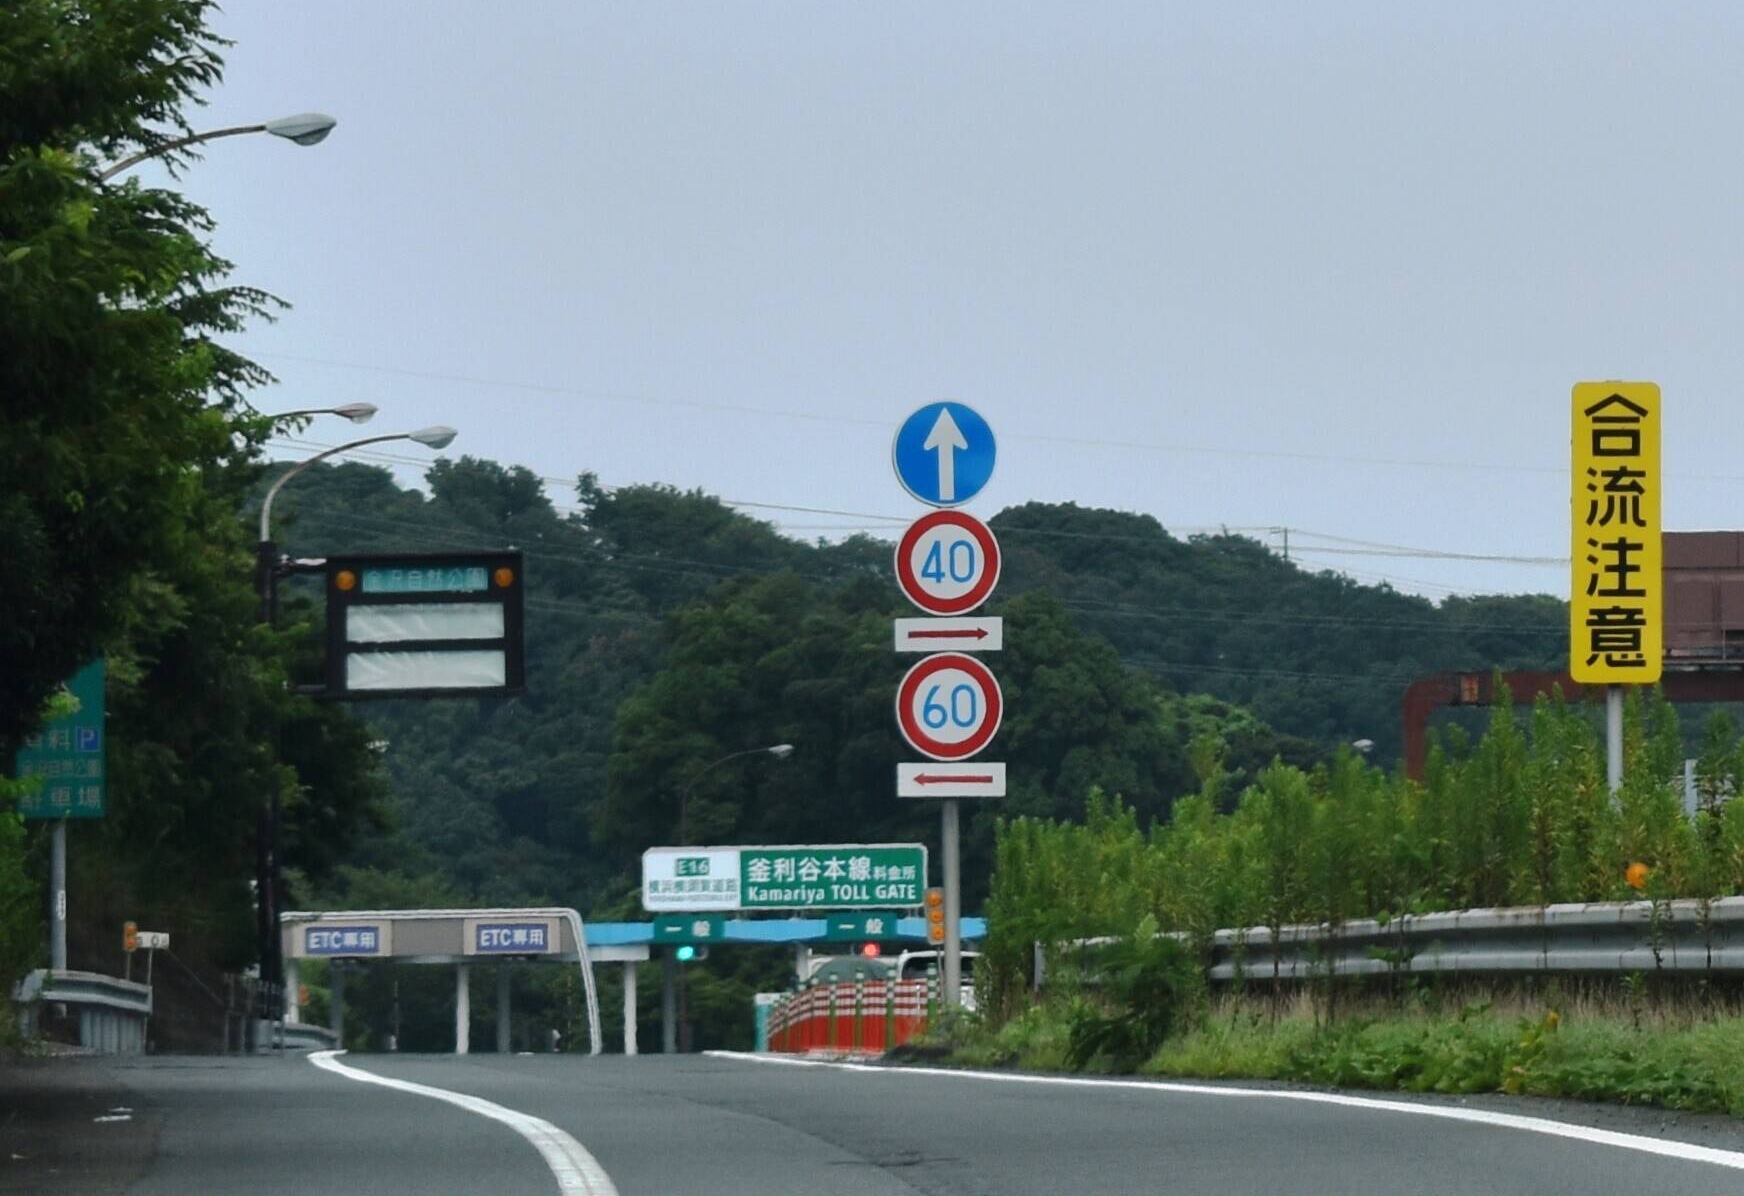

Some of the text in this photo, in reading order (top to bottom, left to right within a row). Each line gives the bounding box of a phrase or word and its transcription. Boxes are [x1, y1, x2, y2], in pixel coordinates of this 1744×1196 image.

[1584, 393, 1649, 668] 合流注意
[921, 539, 975, 584] 40
[922, 683, 977, 729] 60
[677, 859, 709, 875] E16
[748, 885, 825, 904] Kamariya
[830, 884, 871, 900] TOLL
[875, 884, 916, 899] GATE
